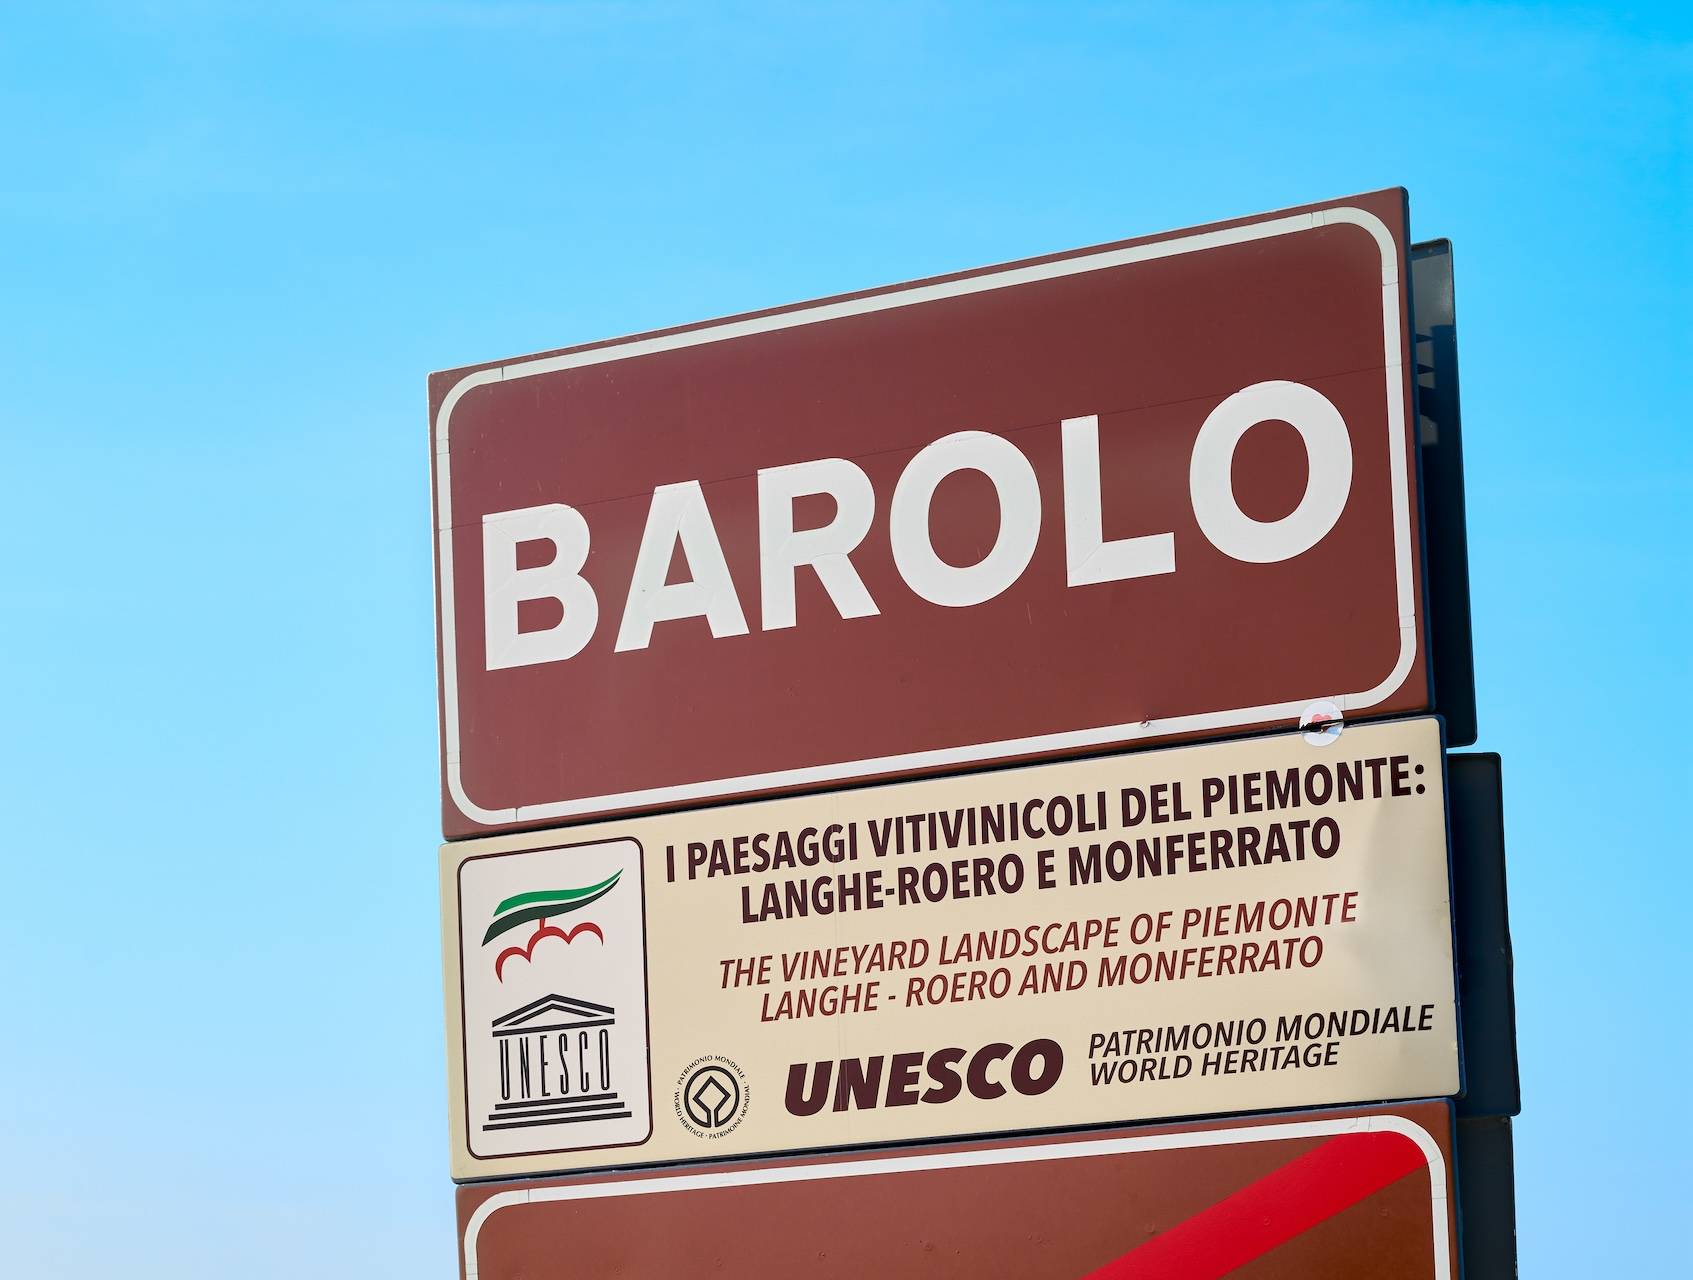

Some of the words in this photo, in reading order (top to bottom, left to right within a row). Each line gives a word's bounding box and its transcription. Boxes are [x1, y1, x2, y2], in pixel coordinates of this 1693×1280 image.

[482, 380, 1354, 671] BAROLO
[666, 845, 675, 883] I
[687, 822, 857, 880] PAESAGGI
[867, 791, 1107, 857] VITIVINICOLI
[1121, 782, 1192, 827] DEL
[1202, 755, 1426, 818] PIEMONTE:
[741, 854, 1024, 923] LANGHE-ROERO
[1037, 850, 1056, 889] E
[1068, 816, 1340, 886] MONFERRATO
[719, 955, 772, 989] THE
[781, 938, 929, 982] VINEYARD
[938, 917, 1120, 965] LANDSCAPE
[1129, 911, 1173, 945] OF
[1181, 891, 1359, 939] PIEMONTE
[760, 981, 880, 1022] LANGHE
[905, 967, 1011, 1007] ROERO
[1017, 960, 1088, 996] AND
[1097, 935, 1323, 987] MONFERRATO
[500, 1029, 610, 1100] UNESCO
[678, 1055, 713, 1085] PATRIMONIO
[714, 1055, 746, 1079] MONDIALE
[1088, 1018, 1266, 1059] PATRIMONIO
[1276, 1004, 1435, 1042] MONDIALE
[1089, 1055, 1193, 1087] WORLD
[1201, 1041, 1340, 1076] HERITAGE
[674, 1089, 683, 1117] WORLD
[679, 1116, 704, 1139] HERITAGE
[785, 1039, 1064, 1117] UNESCO
